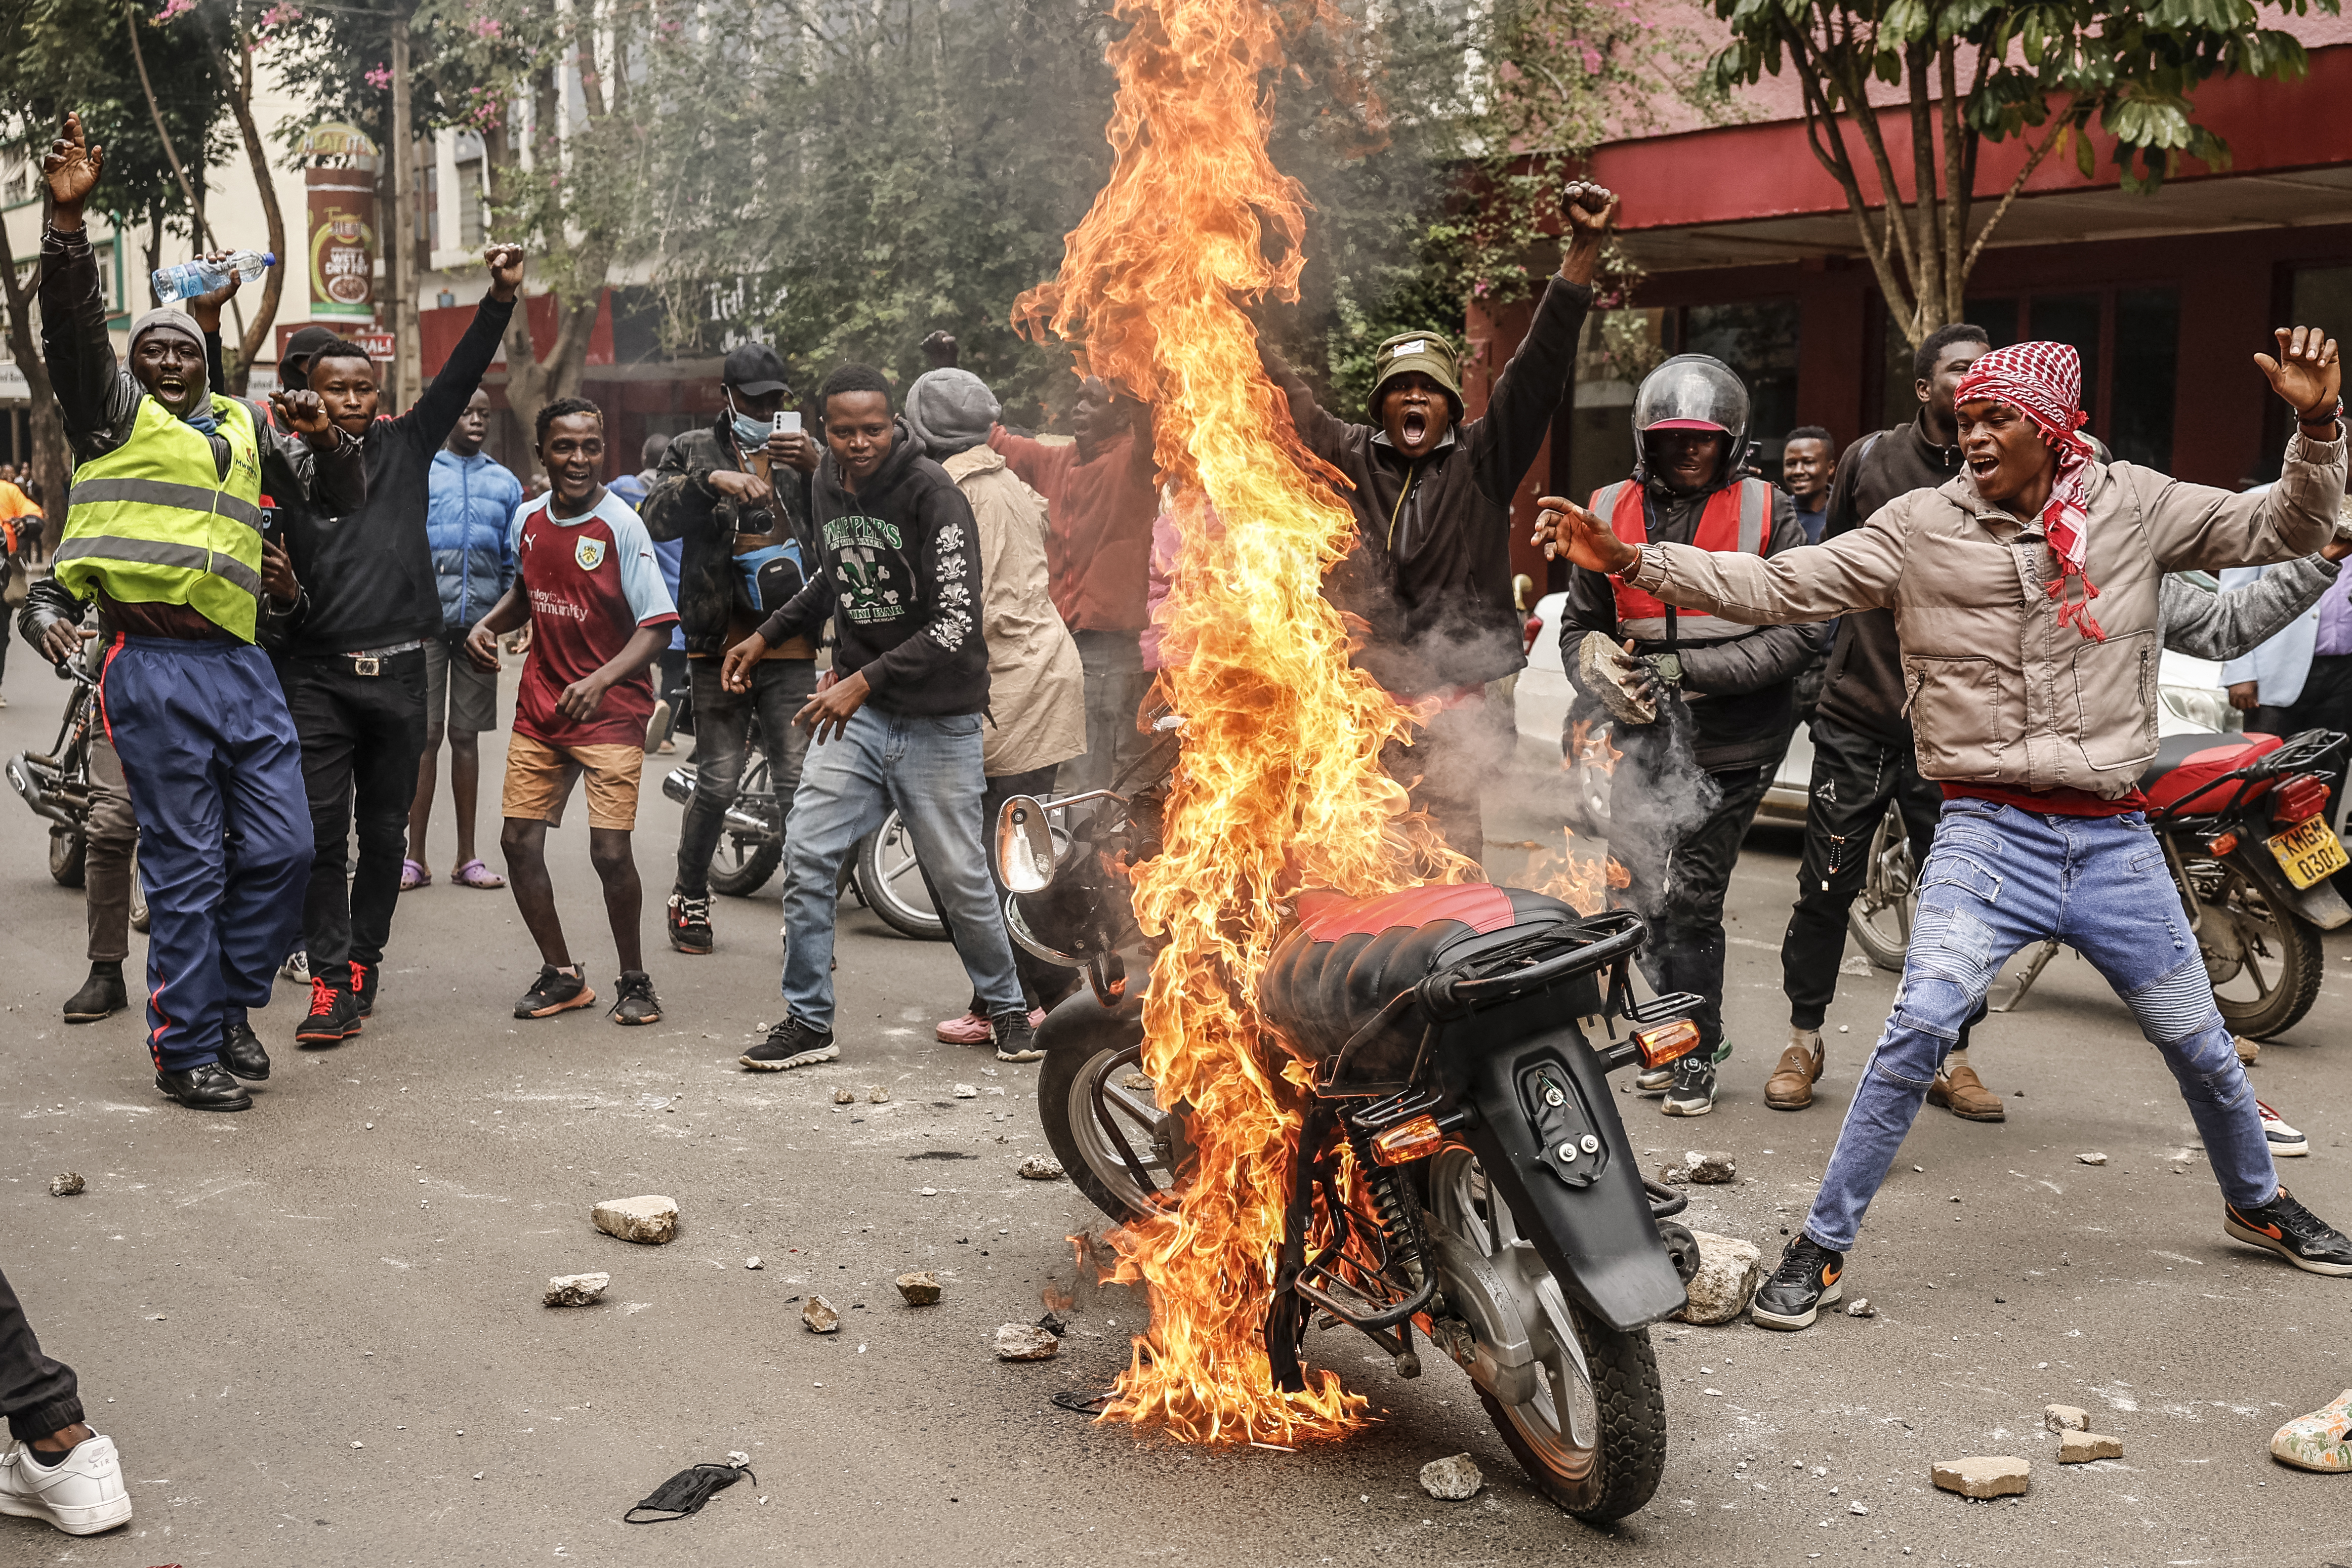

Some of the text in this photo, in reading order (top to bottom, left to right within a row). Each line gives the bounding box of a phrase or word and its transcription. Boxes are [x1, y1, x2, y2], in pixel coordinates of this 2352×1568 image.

[527, 588, 550, 603] nley
[531, 600, 588, 622] mmunity
[872, 605, 905, 617] BAR
[93, 1458, 110, 1469] AIR
